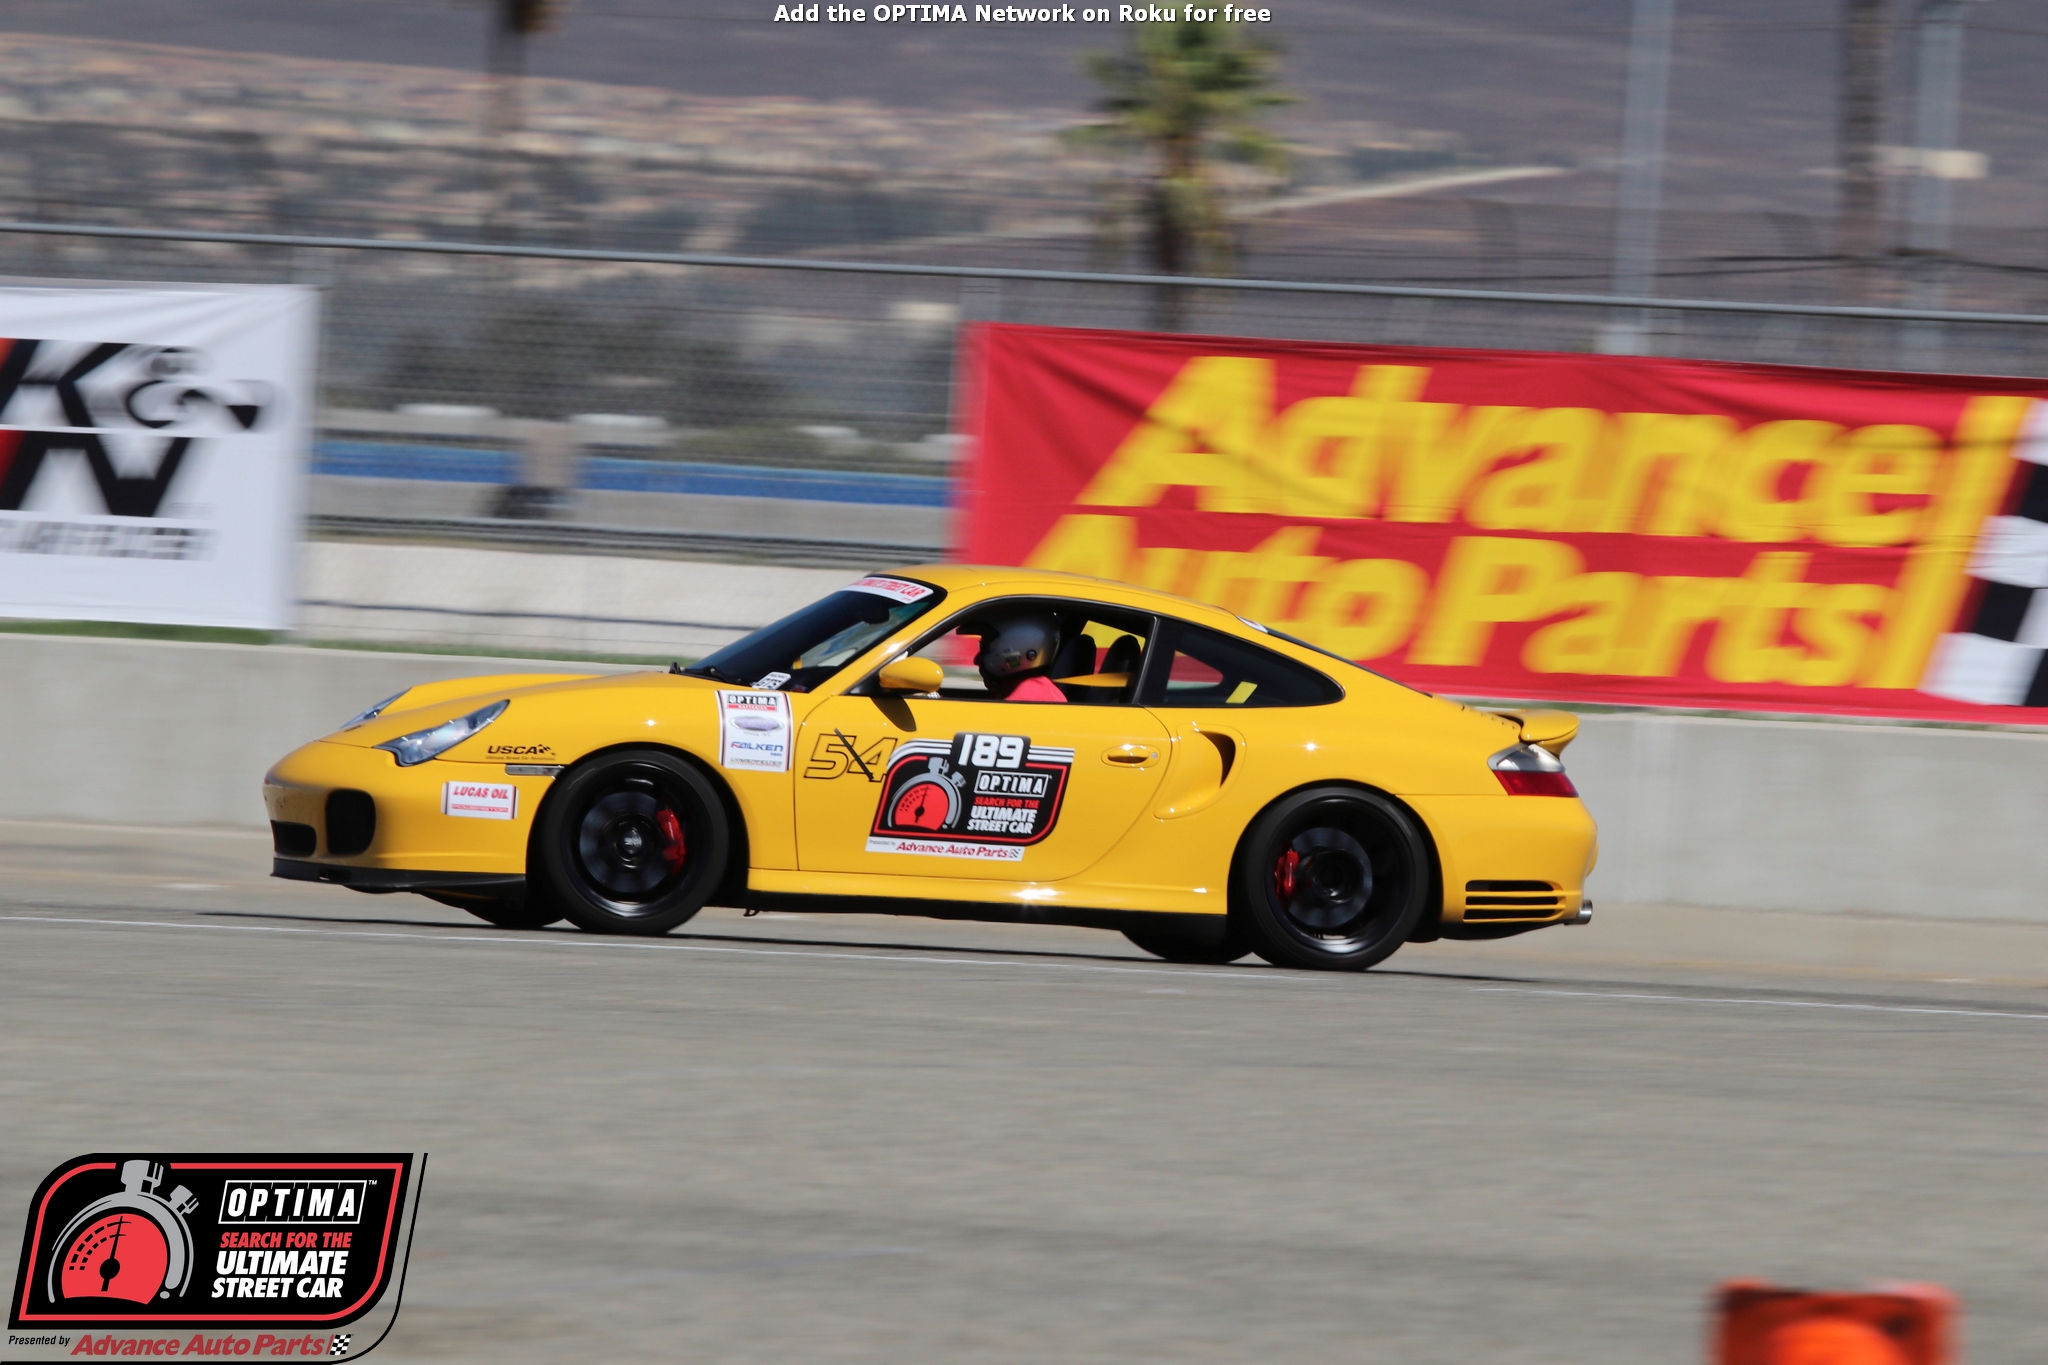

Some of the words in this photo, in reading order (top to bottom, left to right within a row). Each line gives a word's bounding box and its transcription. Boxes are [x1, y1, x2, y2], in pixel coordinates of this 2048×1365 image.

[1074, 354, 1942, 548] Advance
[1404, 536, 1897, 688] Parts
[728, 695, 776, 706] OPTIMA
[487, 745, 537, 754] USCA
[731, 741, 784, 752] FALKEN
[958, 734, 1024, 768] 189
[803, 732, 898, 783] 54
[453, 786, 489, 798] LUCAS
[491, 788, 509, 799] OIL
[978, 774, 1043, 794] OPTIMA
[974, 796, 1005, 806] SEARCH
[1006, 798, 1022, 808] FOR
[1025, 800, 1040, 809] THE
[970, 805, 1038, 823] ULTIMATE
[967, 819, 1009, 833] STREET
[1008, 822, 1034, 834] CAR
[896, 841, 944, 854] Advance
[945, 844, 976, 856] Auto
[976, 846, 1009, 858] Parts
